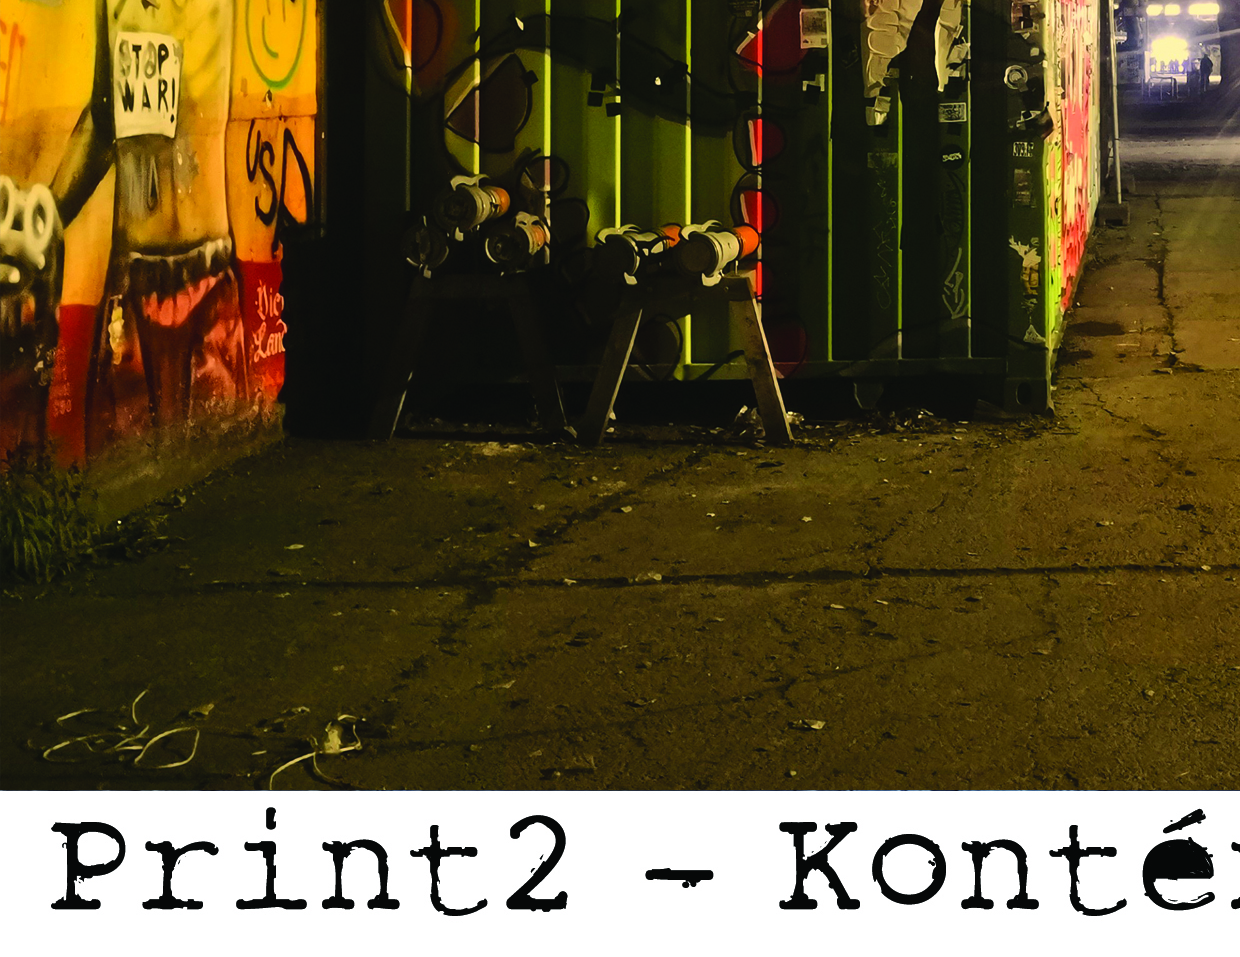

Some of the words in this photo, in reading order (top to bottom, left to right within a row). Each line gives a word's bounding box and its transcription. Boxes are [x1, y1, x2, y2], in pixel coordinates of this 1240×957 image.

[118, 38, 170, 80] STOP
[118, 77, 176, 124] WAR!
[246, 119, 314, 243] USA
